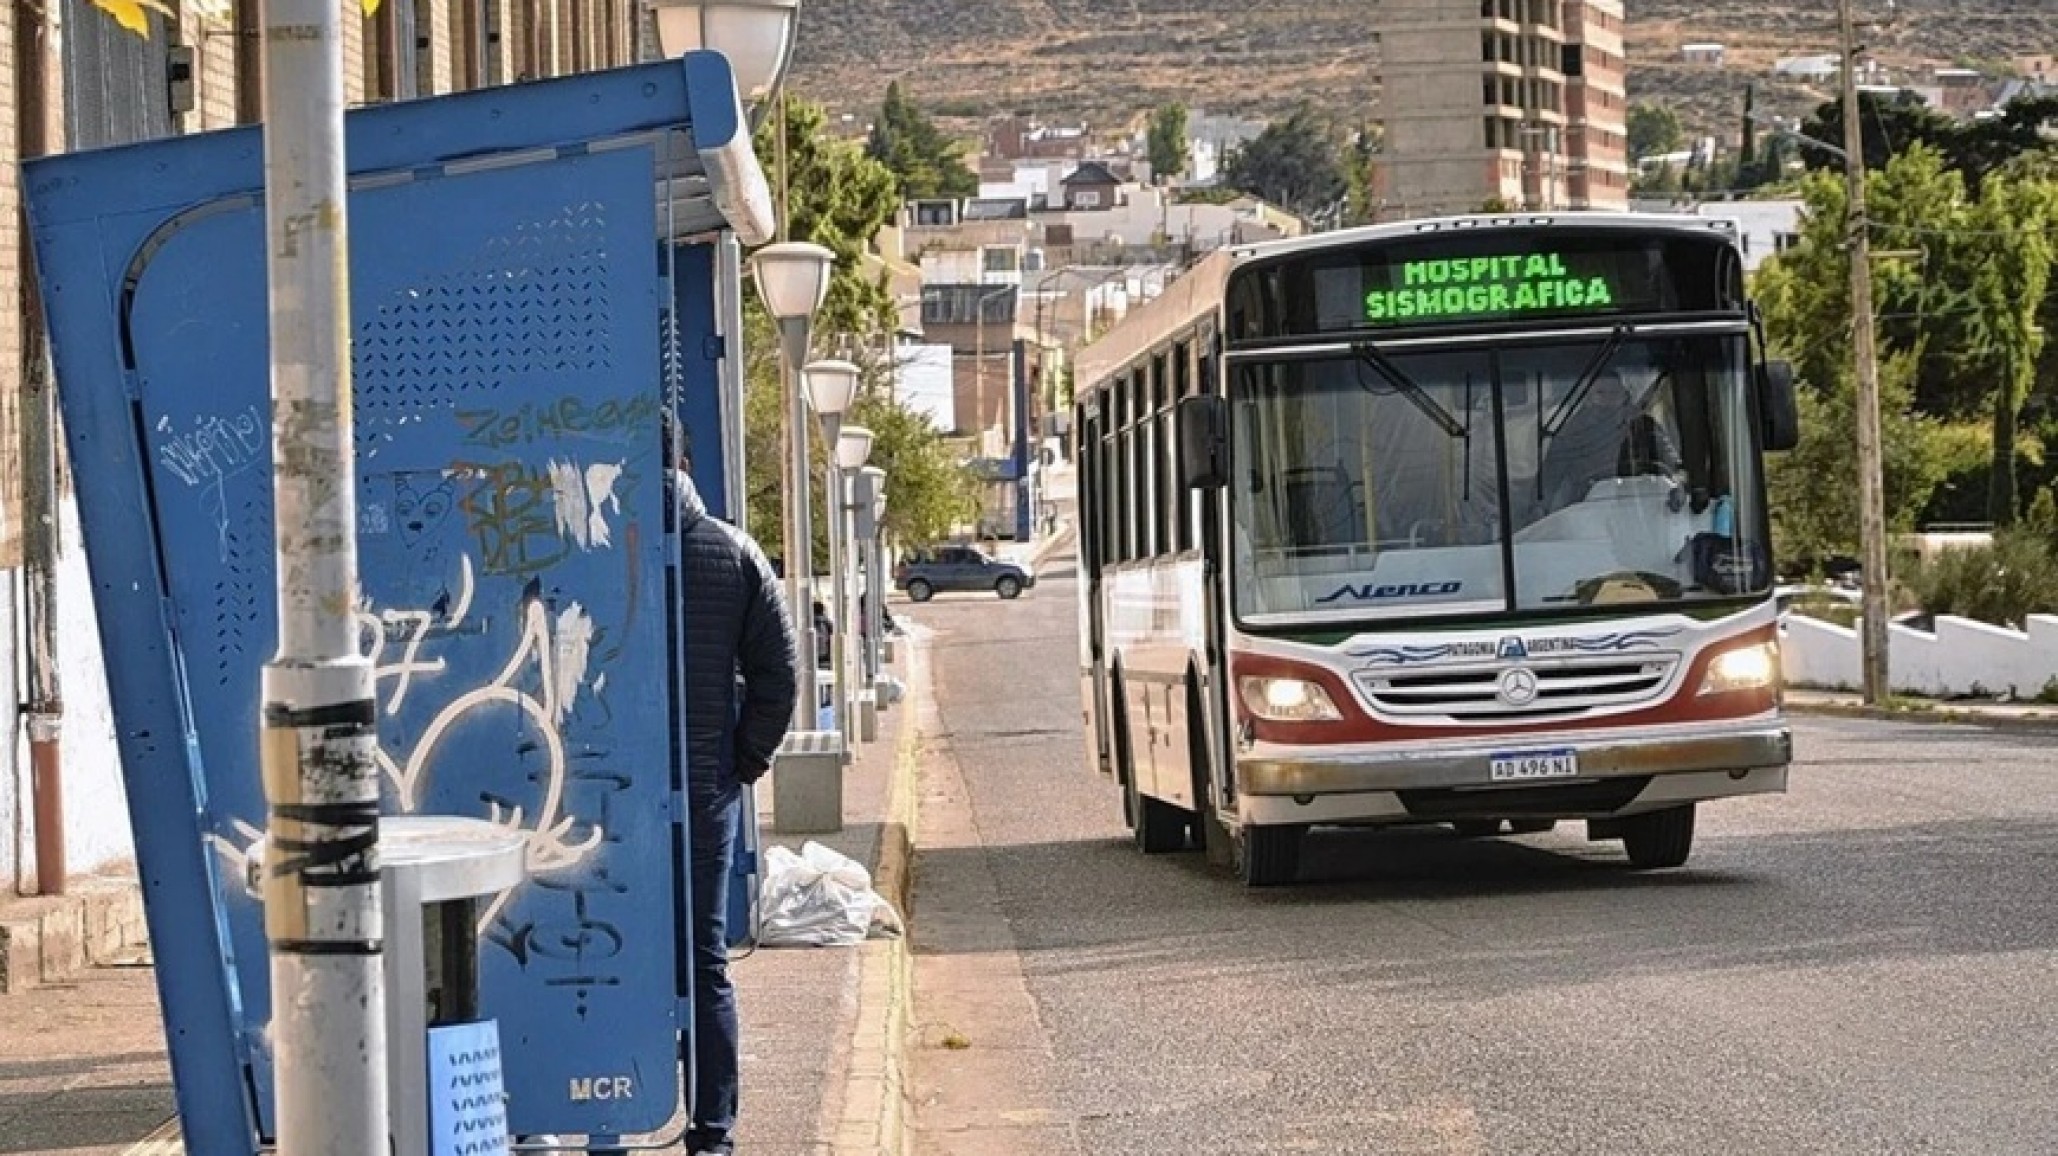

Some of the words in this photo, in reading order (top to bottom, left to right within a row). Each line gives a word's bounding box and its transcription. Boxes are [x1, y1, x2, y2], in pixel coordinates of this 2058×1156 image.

[1404, 253, 1566, 285] HOSPITAL
[1366, 277, 1611, 318] SISMOGRAFICA
[1315, 580, 1463, 602] Alenco
[1496, 762, 1514, 776] AD
[1519, 758, 1548, 775] 496
[569, 1077, 632, 1099] MCR
